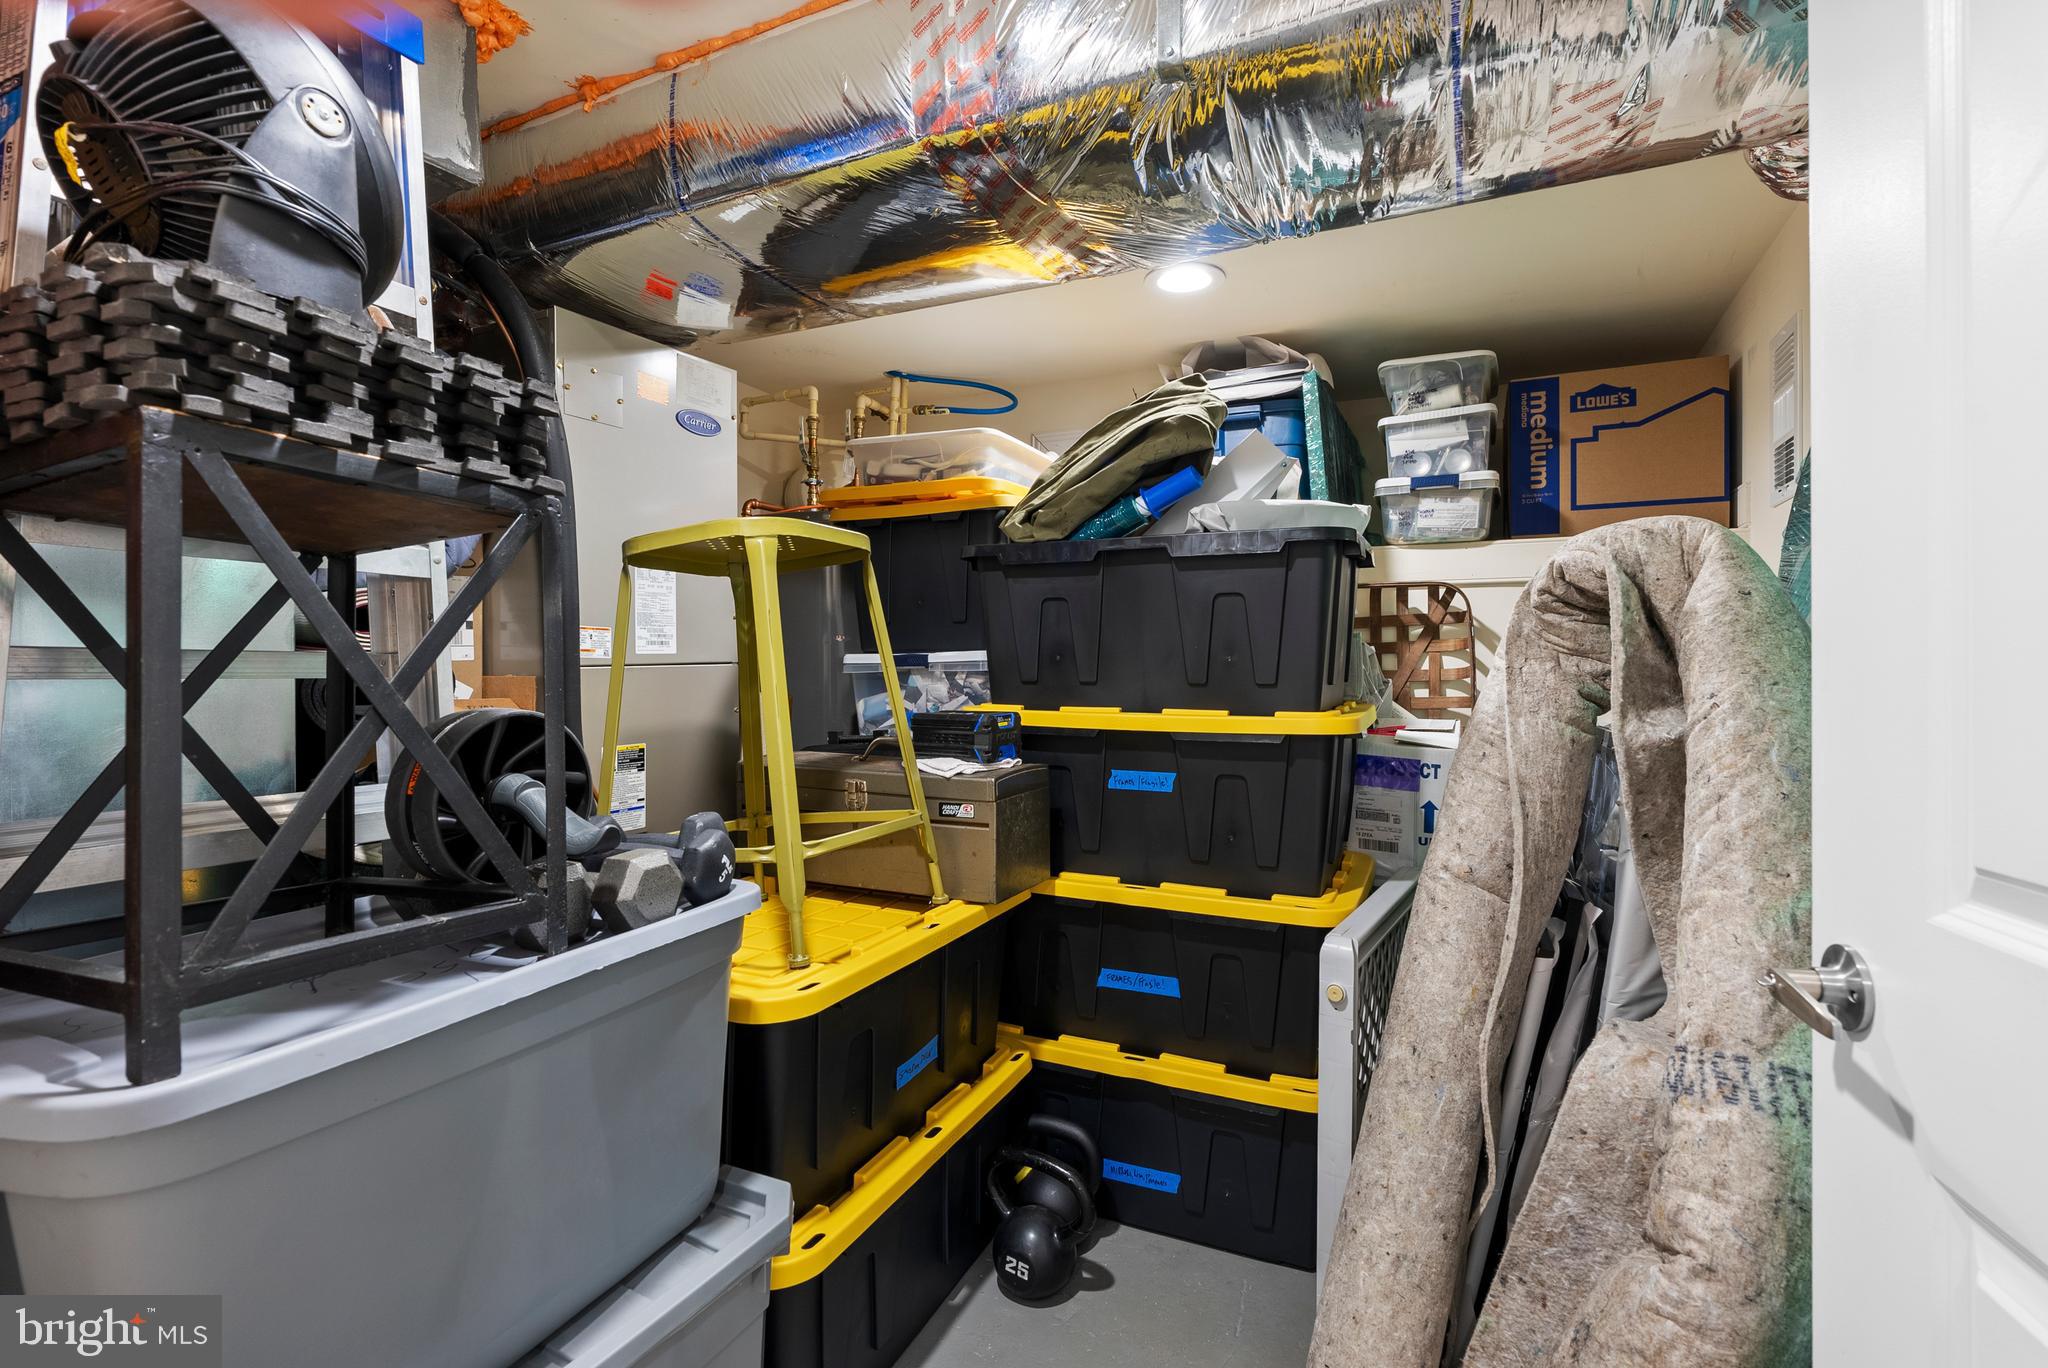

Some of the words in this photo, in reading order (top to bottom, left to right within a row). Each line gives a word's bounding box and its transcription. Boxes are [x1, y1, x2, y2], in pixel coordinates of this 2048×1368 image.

[1576, 392, 1631, 409] LOWE'S
[683, 414, 717, 431] Carrier
[1530, 390, 1554, 490] medium
[1004, 1255, 1029, 1281] 25
